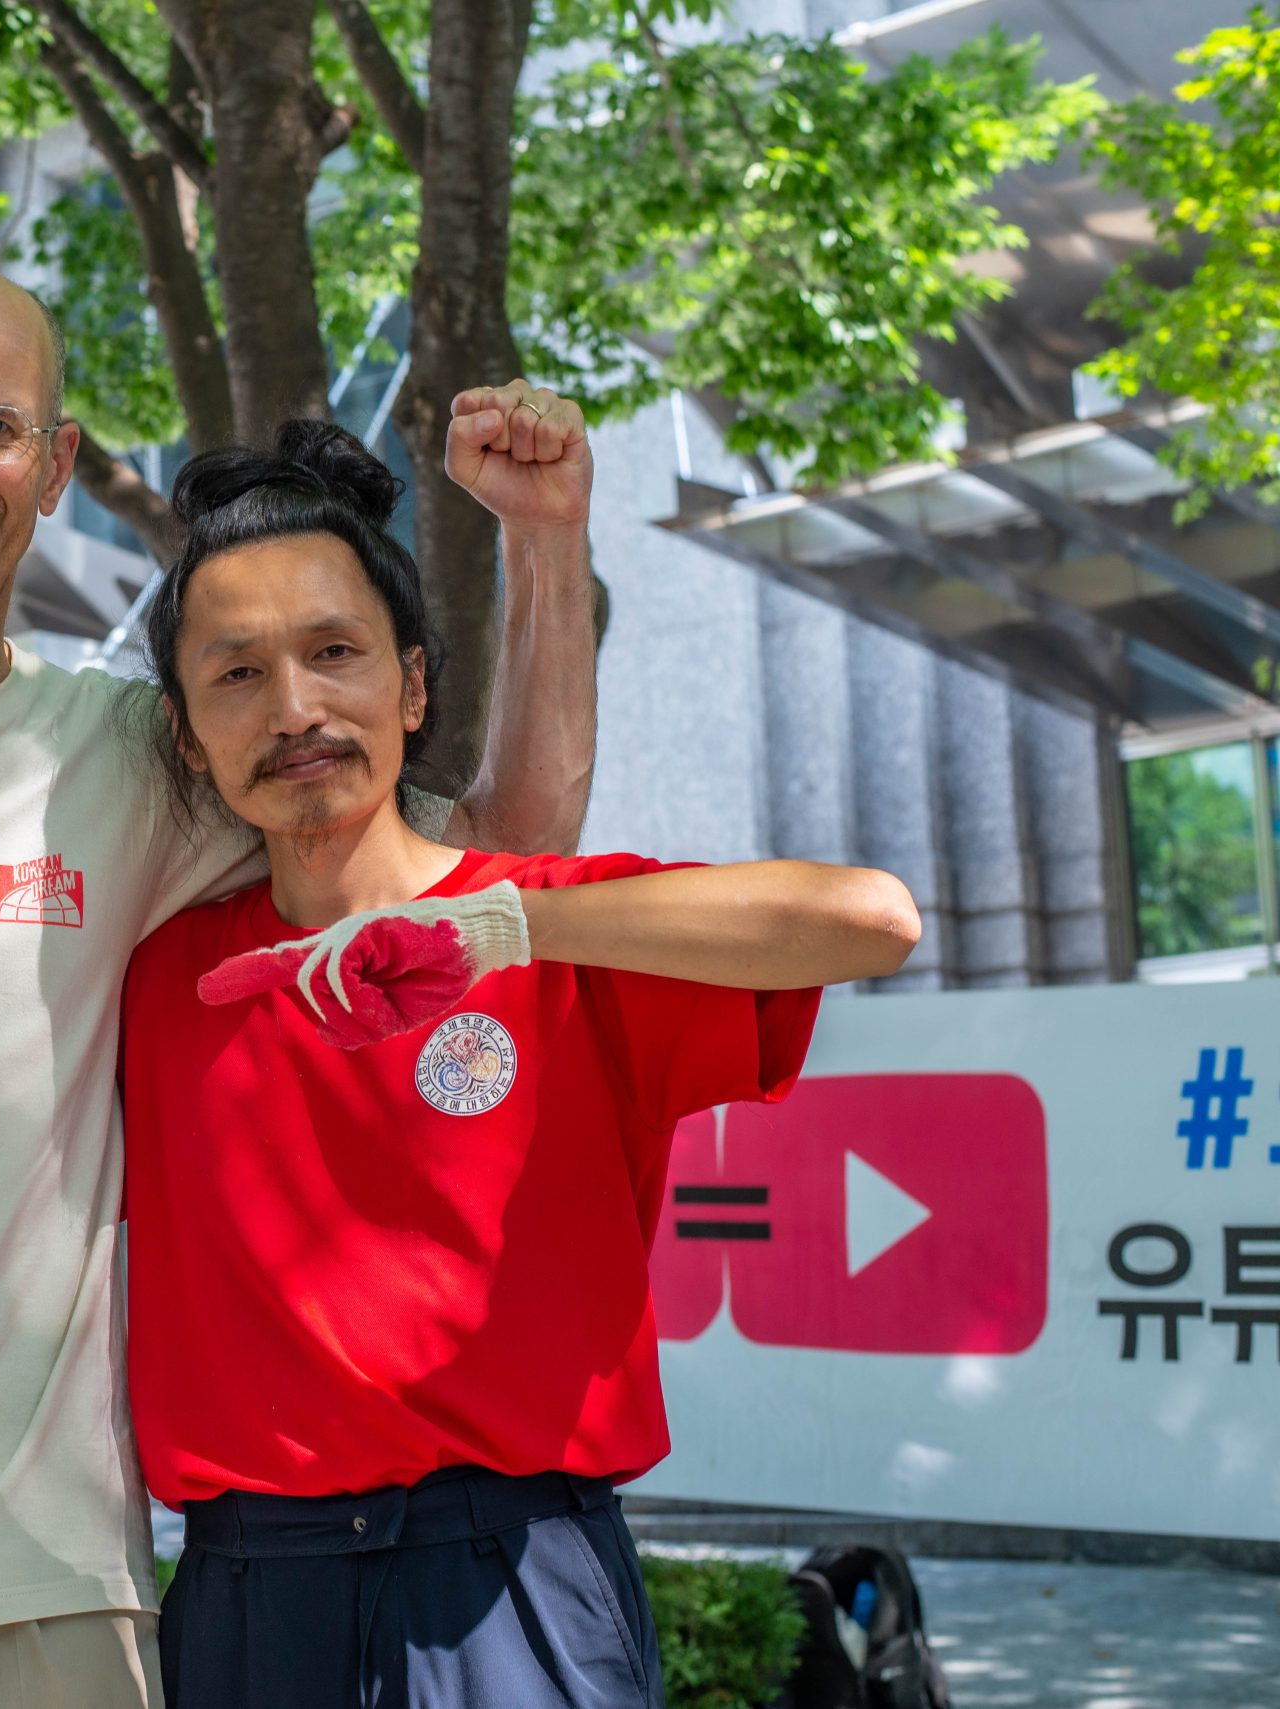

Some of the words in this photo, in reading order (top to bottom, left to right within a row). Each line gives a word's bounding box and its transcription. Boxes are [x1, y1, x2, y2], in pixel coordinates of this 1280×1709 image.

[13, 852, 62, 884] KOREAN
[30, 871, 76, 900] DREAM
[436, 1016, 497, 1039] 국제혁명당
